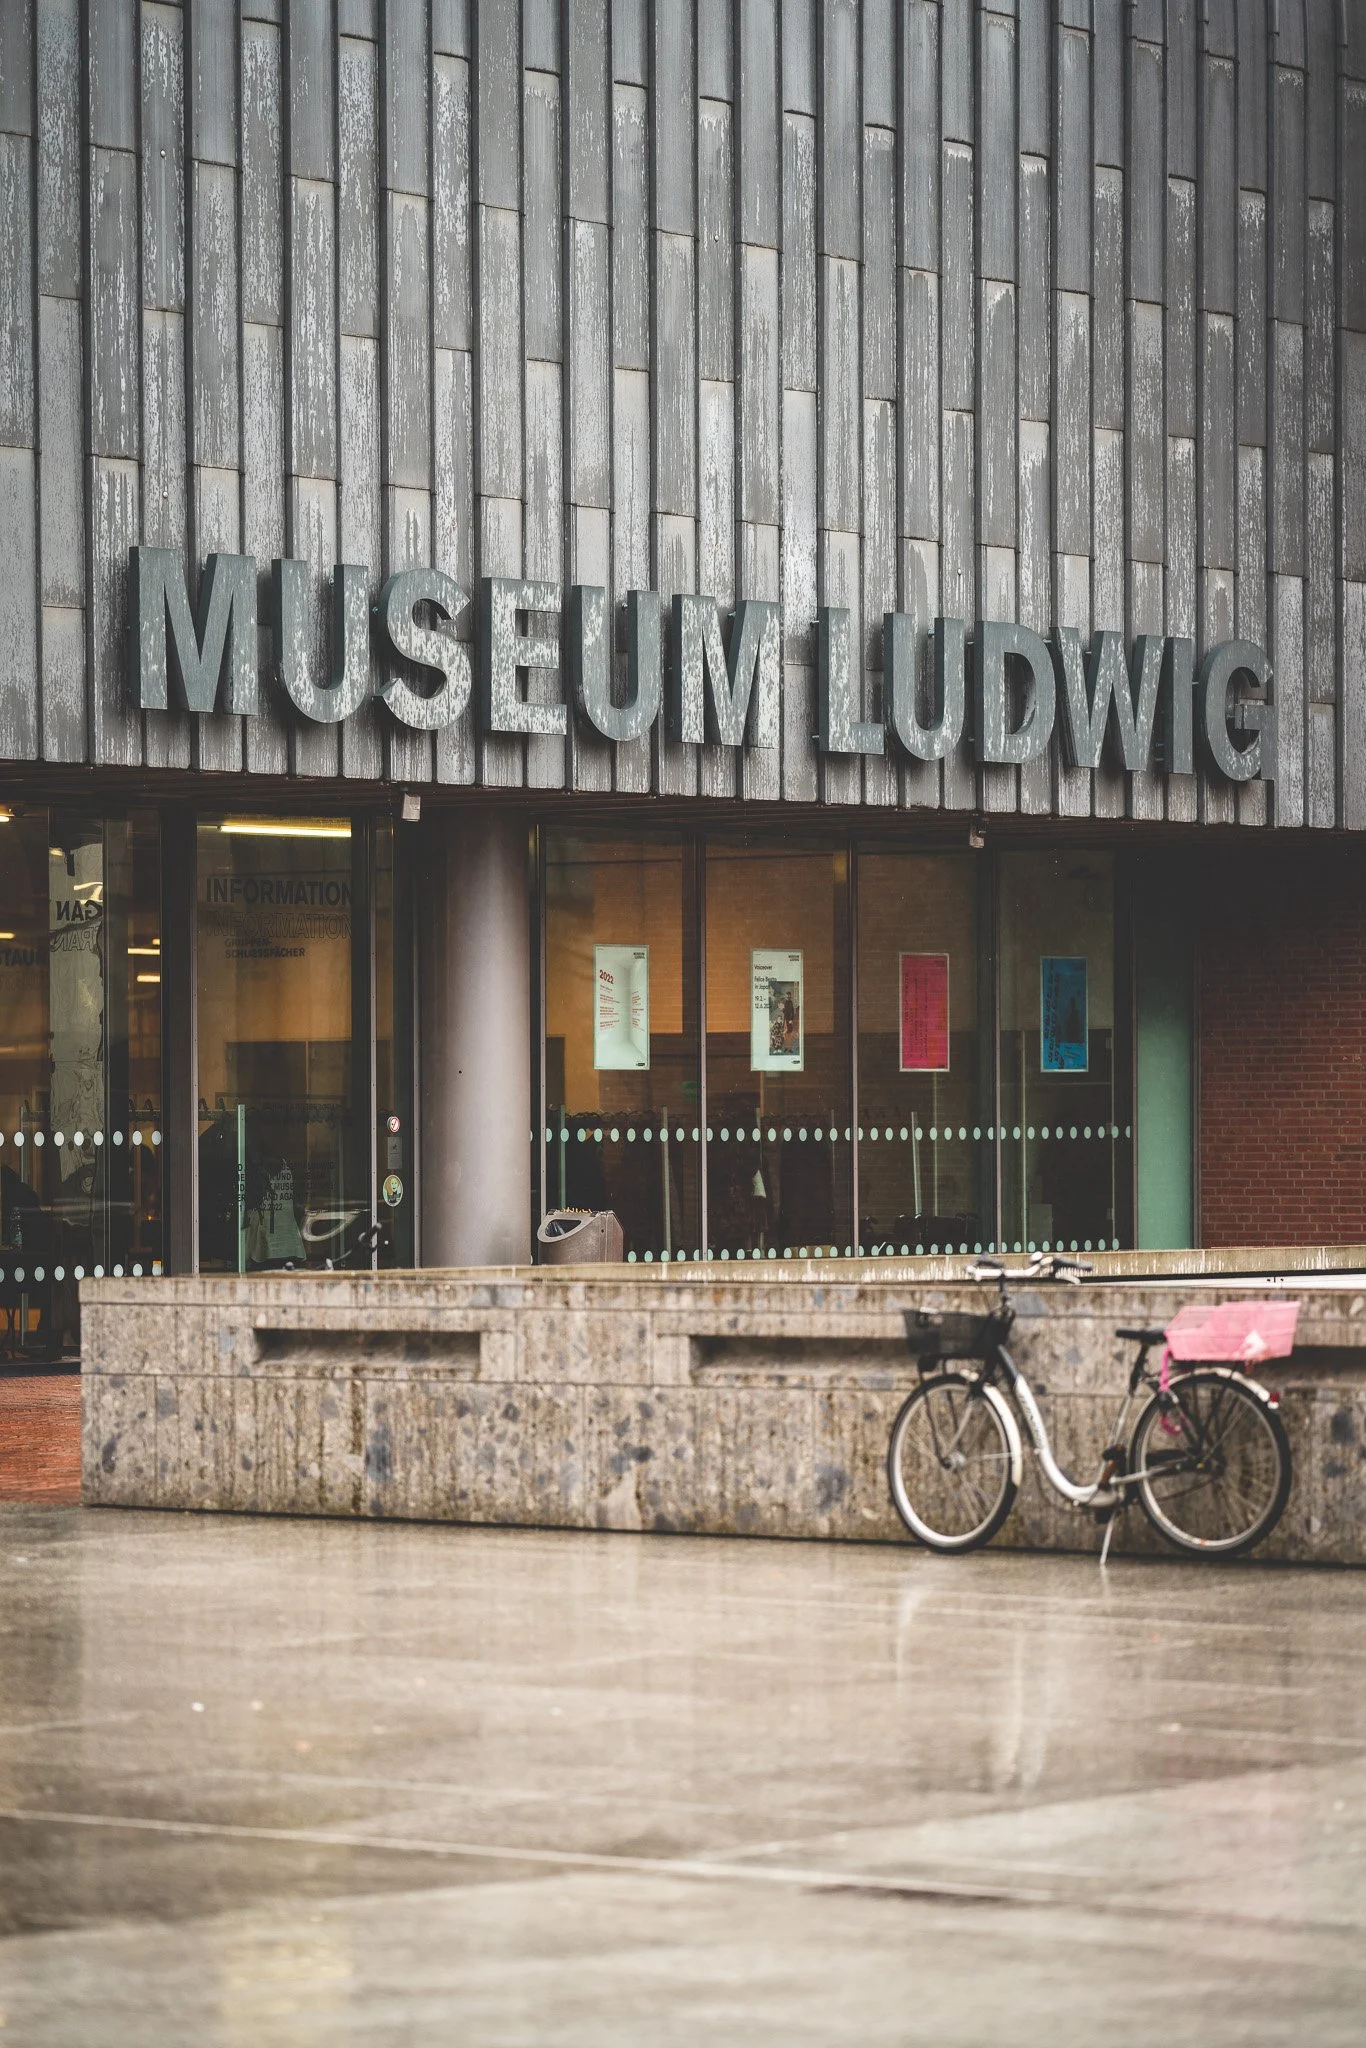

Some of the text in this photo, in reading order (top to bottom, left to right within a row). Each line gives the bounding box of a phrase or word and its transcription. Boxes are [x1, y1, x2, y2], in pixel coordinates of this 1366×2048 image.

[128, 545, 1276, 782] MUSEUM LUDWIG
[206, 878, 354, 906] INFORMATION
[206, 910, 352, 939] INFORMATION
[599, 969, 614, 985] 2022
